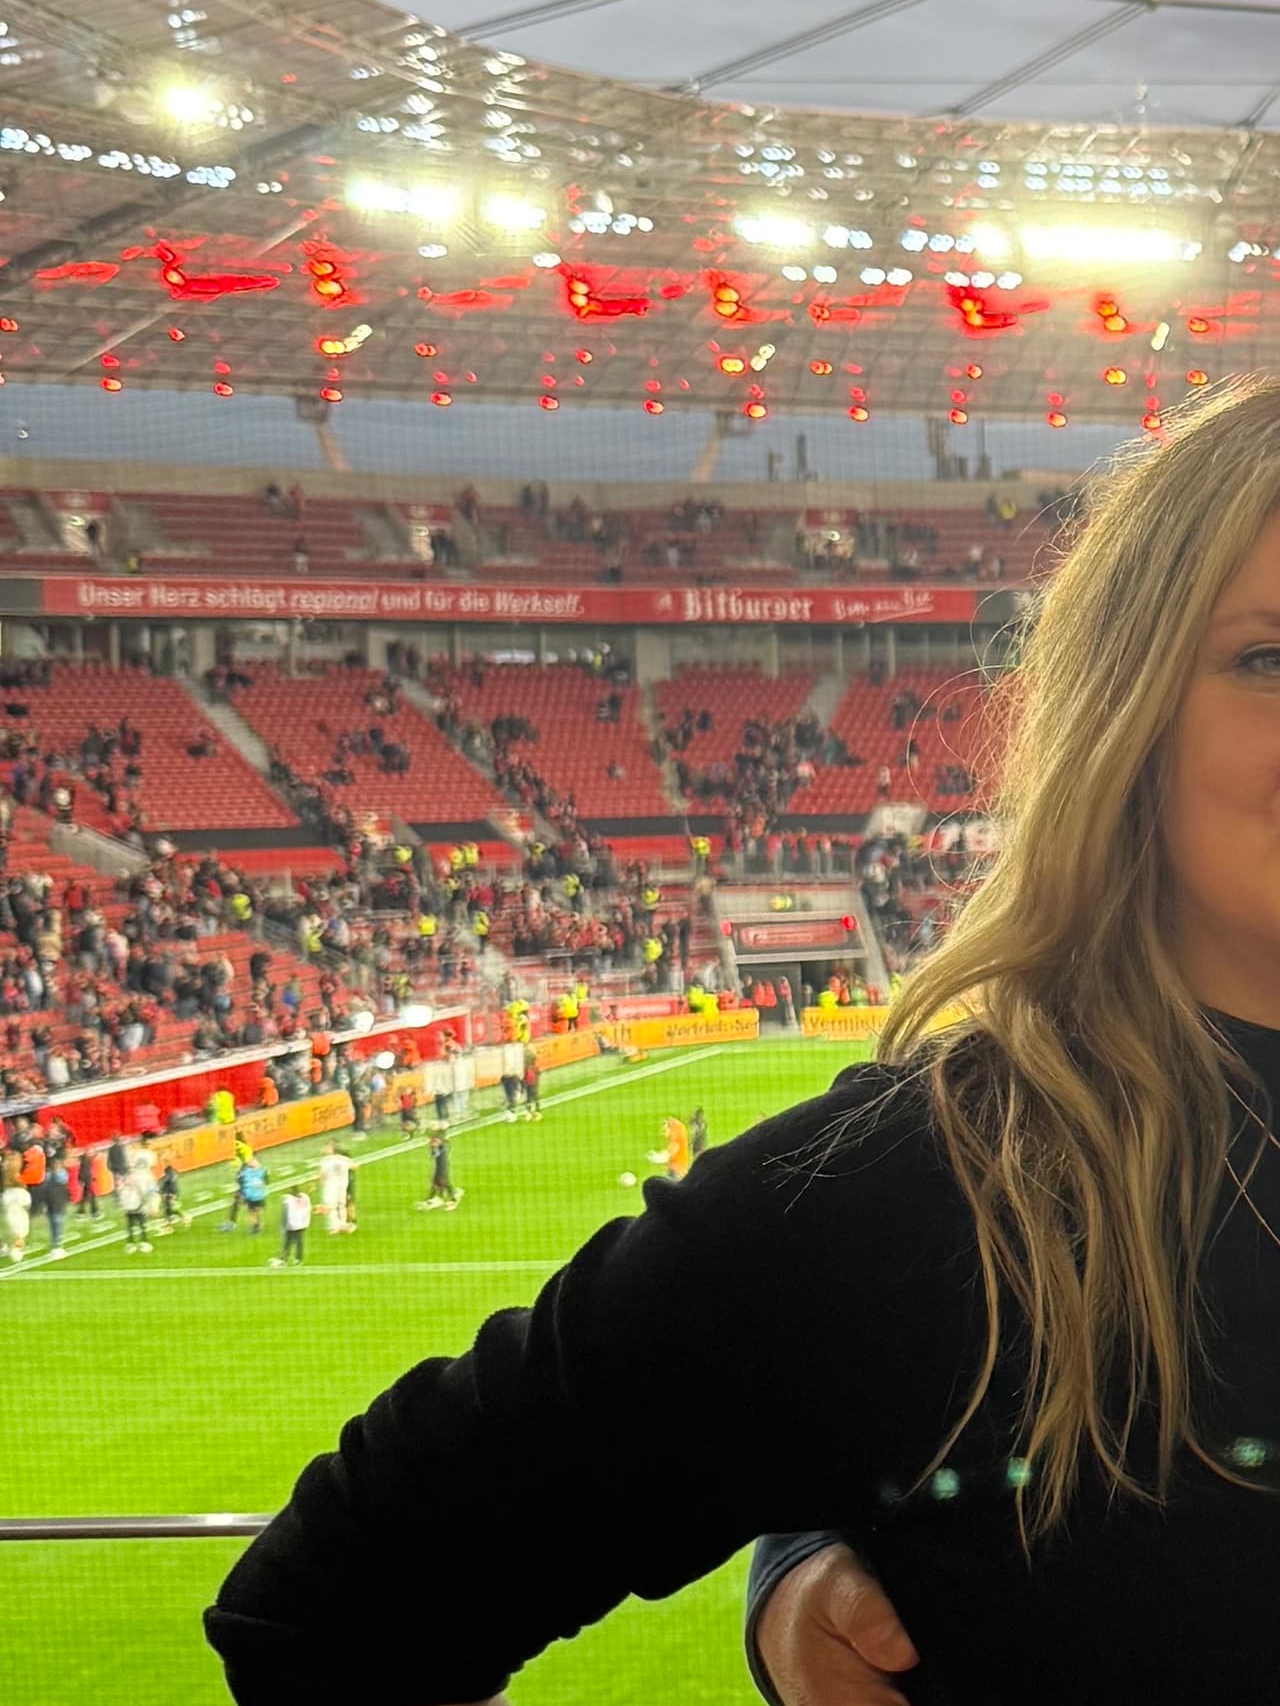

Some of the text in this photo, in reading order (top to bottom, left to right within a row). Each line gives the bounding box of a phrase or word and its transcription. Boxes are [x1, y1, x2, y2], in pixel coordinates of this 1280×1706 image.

[79, 580, 145, 607] Unser
[150, 584, 200, 608] Herz
[289, 588, 378, 613] regional
[381, 589, 421, 611] und
[425, 590, 456, 611] für
[459, 591, 490, 613] die
[682, 588, 814, 622] Bitburger
